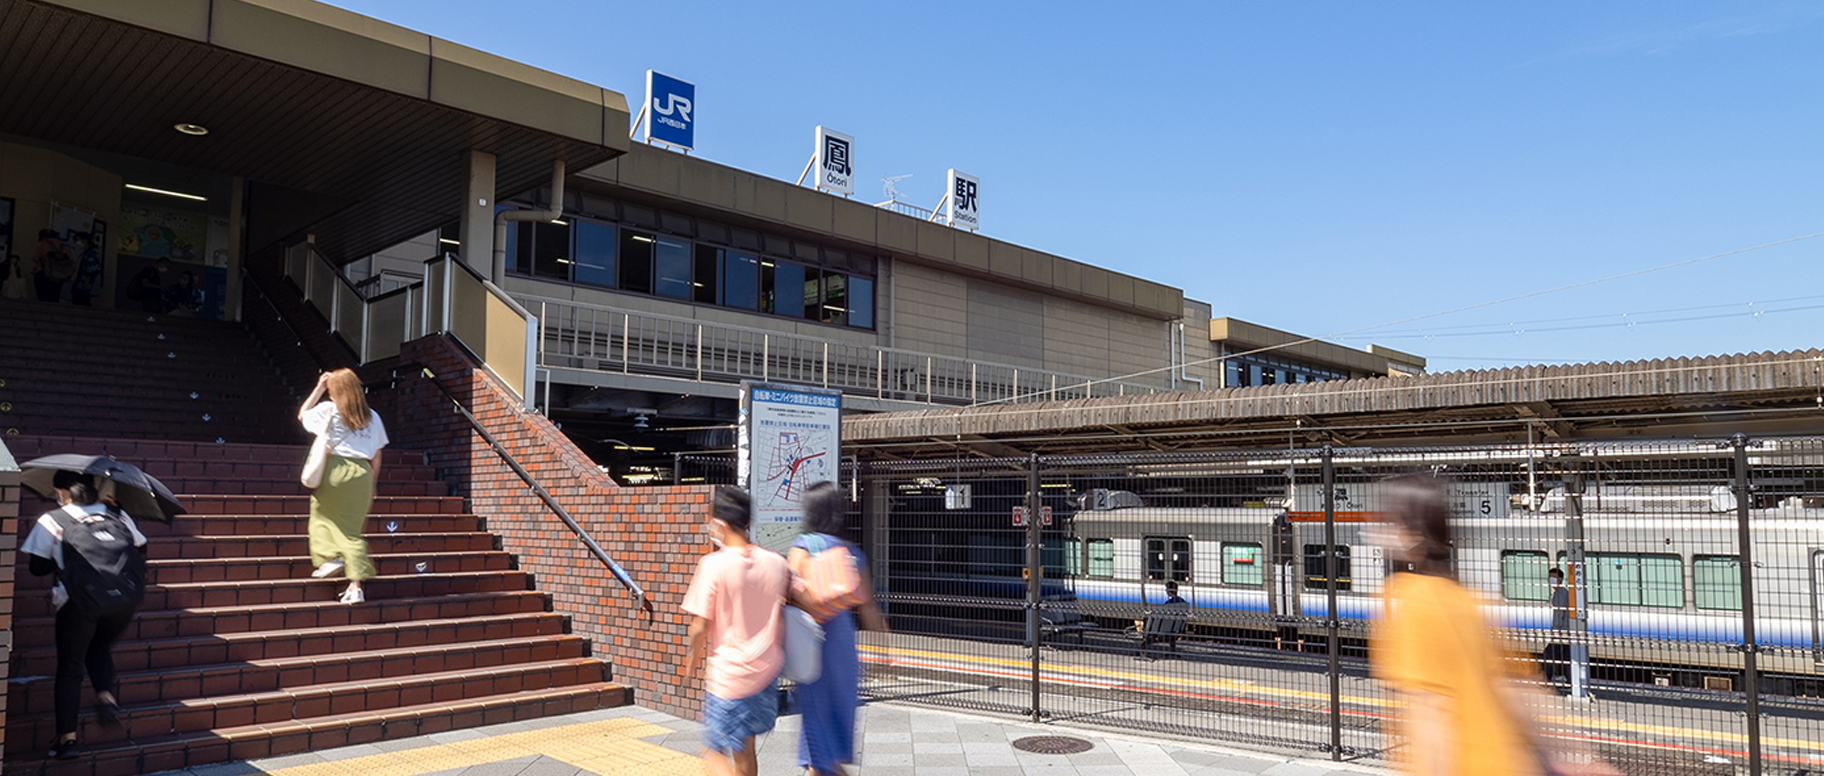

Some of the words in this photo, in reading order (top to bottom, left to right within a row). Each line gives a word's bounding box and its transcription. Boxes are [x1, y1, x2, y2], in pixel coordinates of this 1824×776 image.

[653, 92, 692, 123] JR
[657, 116, 687, 130] JR西日本
[822, 134, 852, 177] 鳳
[954, 176, 977, 213] 駅
[954, 211, 977, 224] Station
[960, 488, 965, 506] 1
[1097, 491, 1105, 508] 2
[1481, 500, 1491, 515] 5
